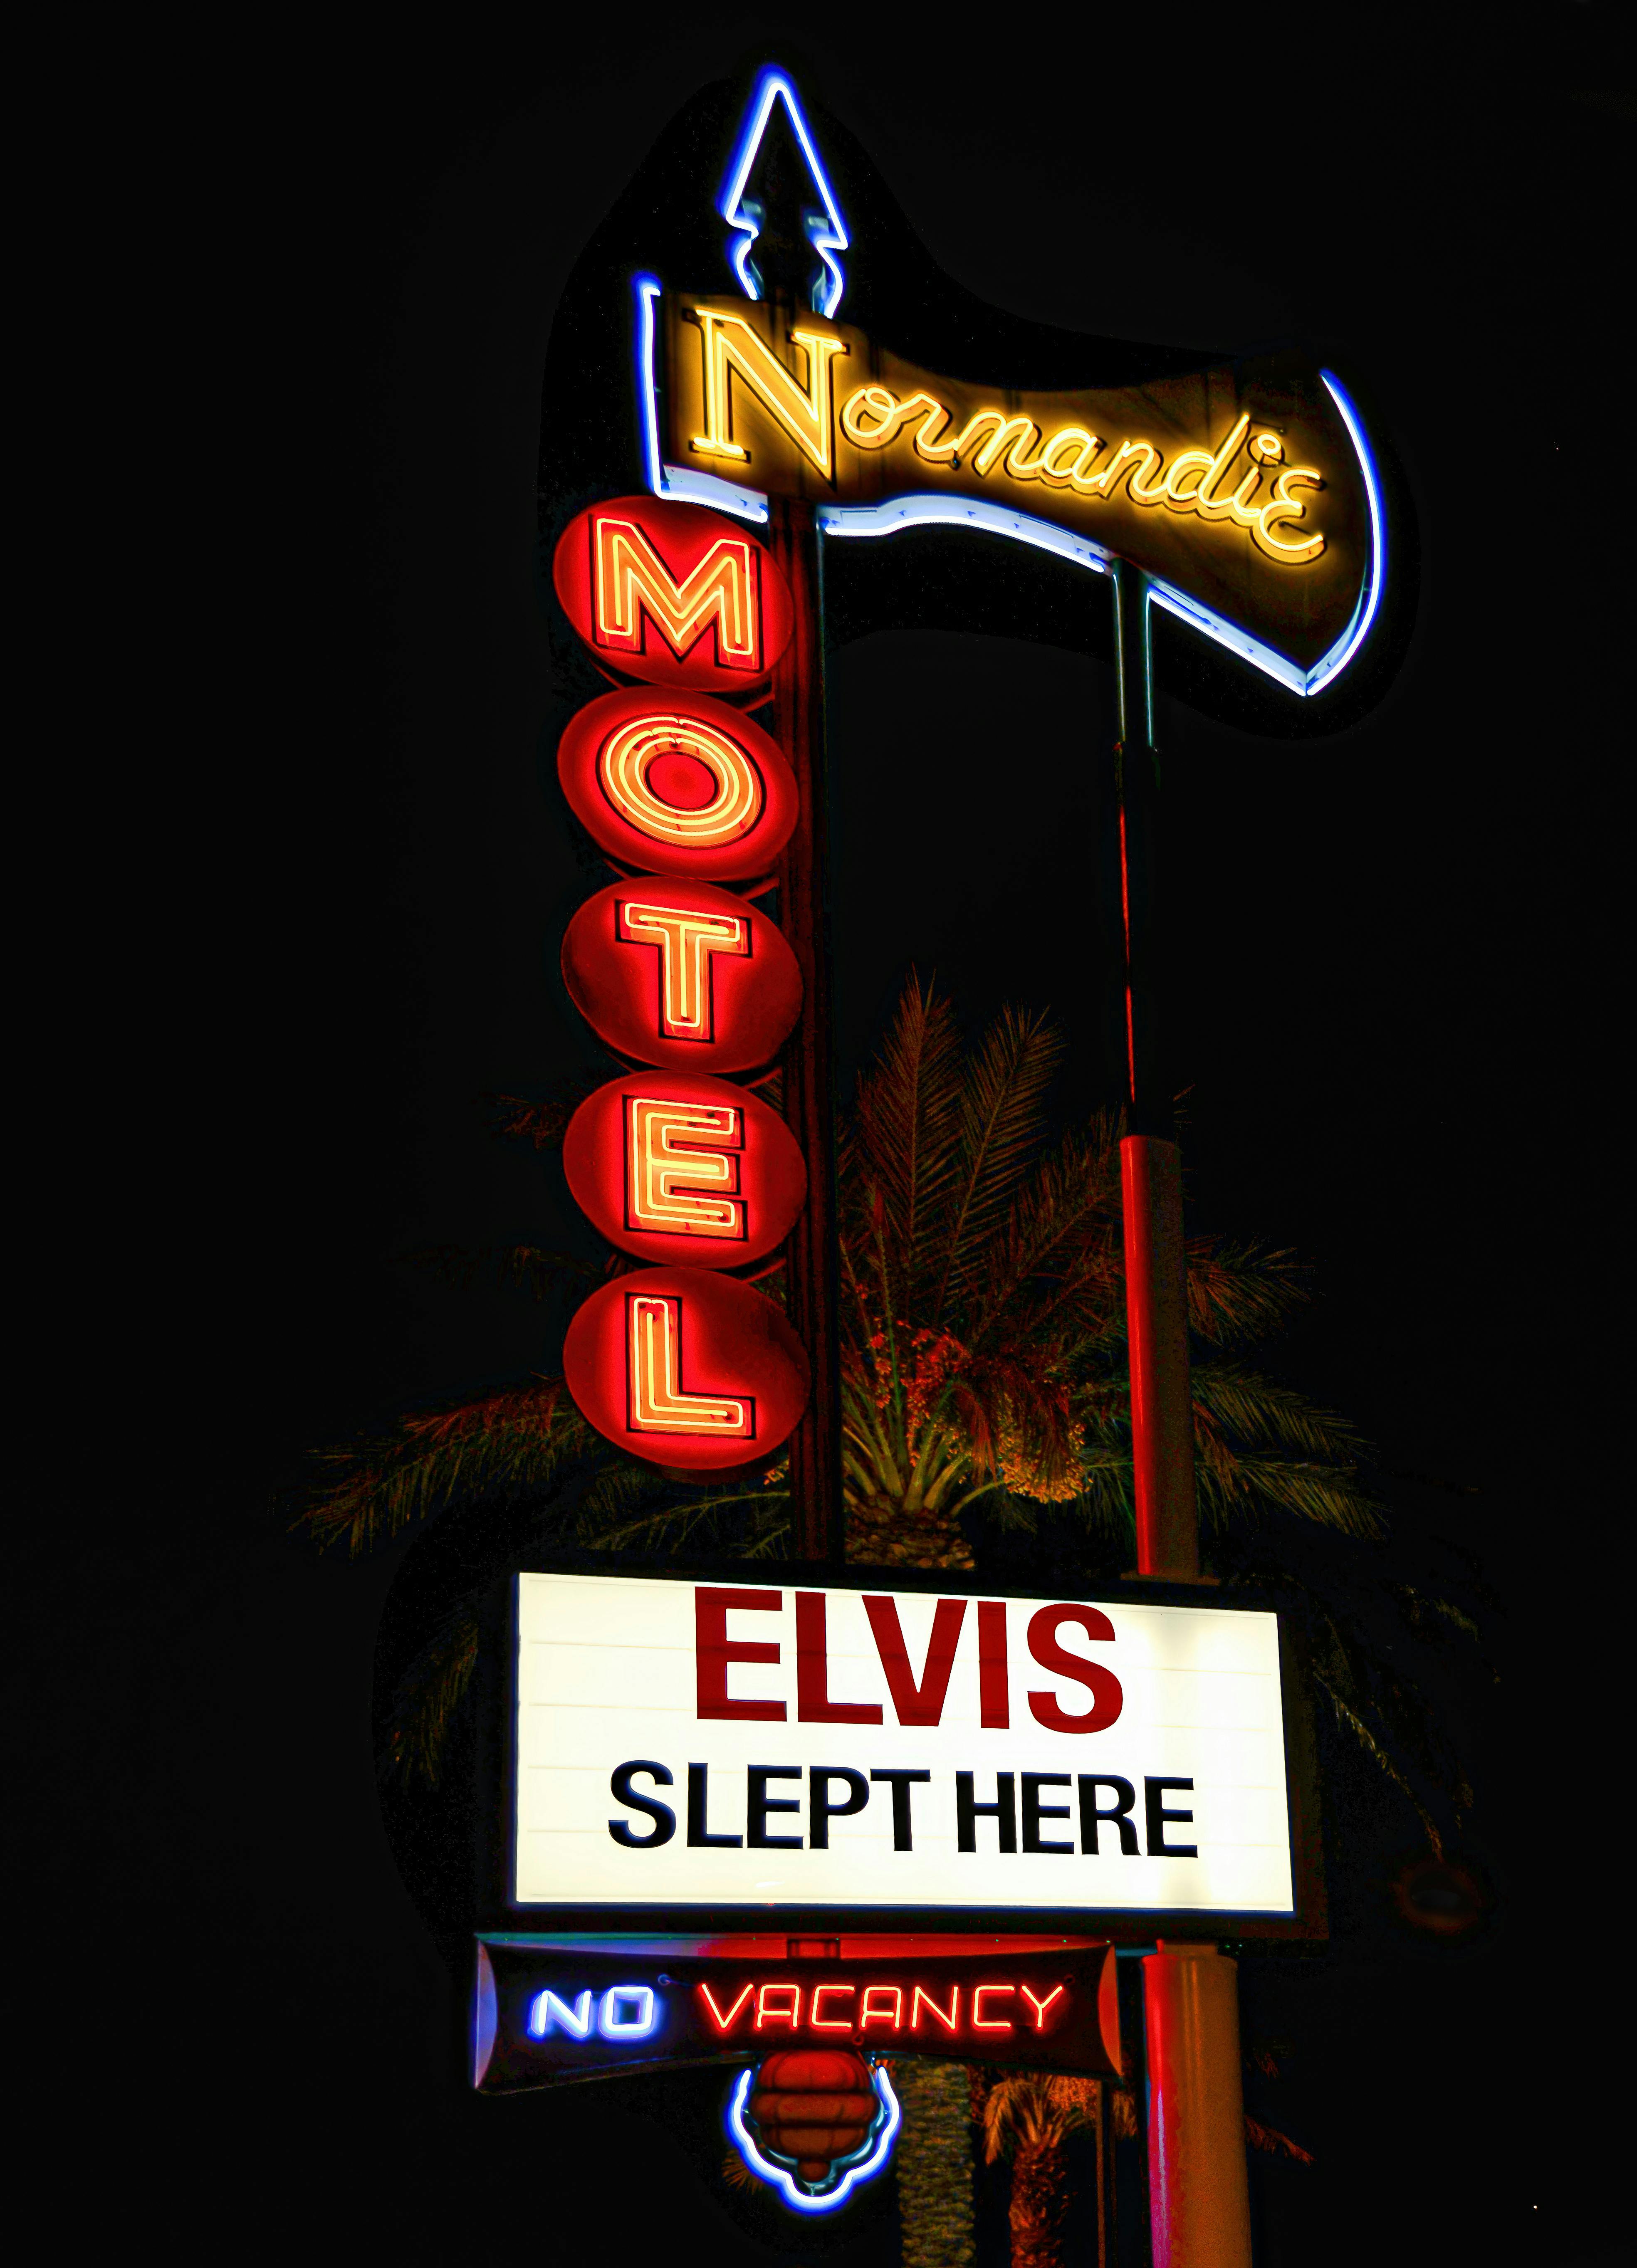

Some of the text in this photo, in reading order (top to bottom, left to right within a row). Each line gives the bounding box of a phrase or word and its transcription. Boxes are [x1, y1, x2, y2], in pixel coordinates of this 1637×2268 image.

[684, 308, 1326, 564] Normandie
[591, 515, 763, 1440] MOTEL
[695, 1586, 1123, 1734] ELVIS
[608, 1760, 1199, 1858] SLEPT HERE
[528, 1981, 1065, 2040] NO VACANCY
